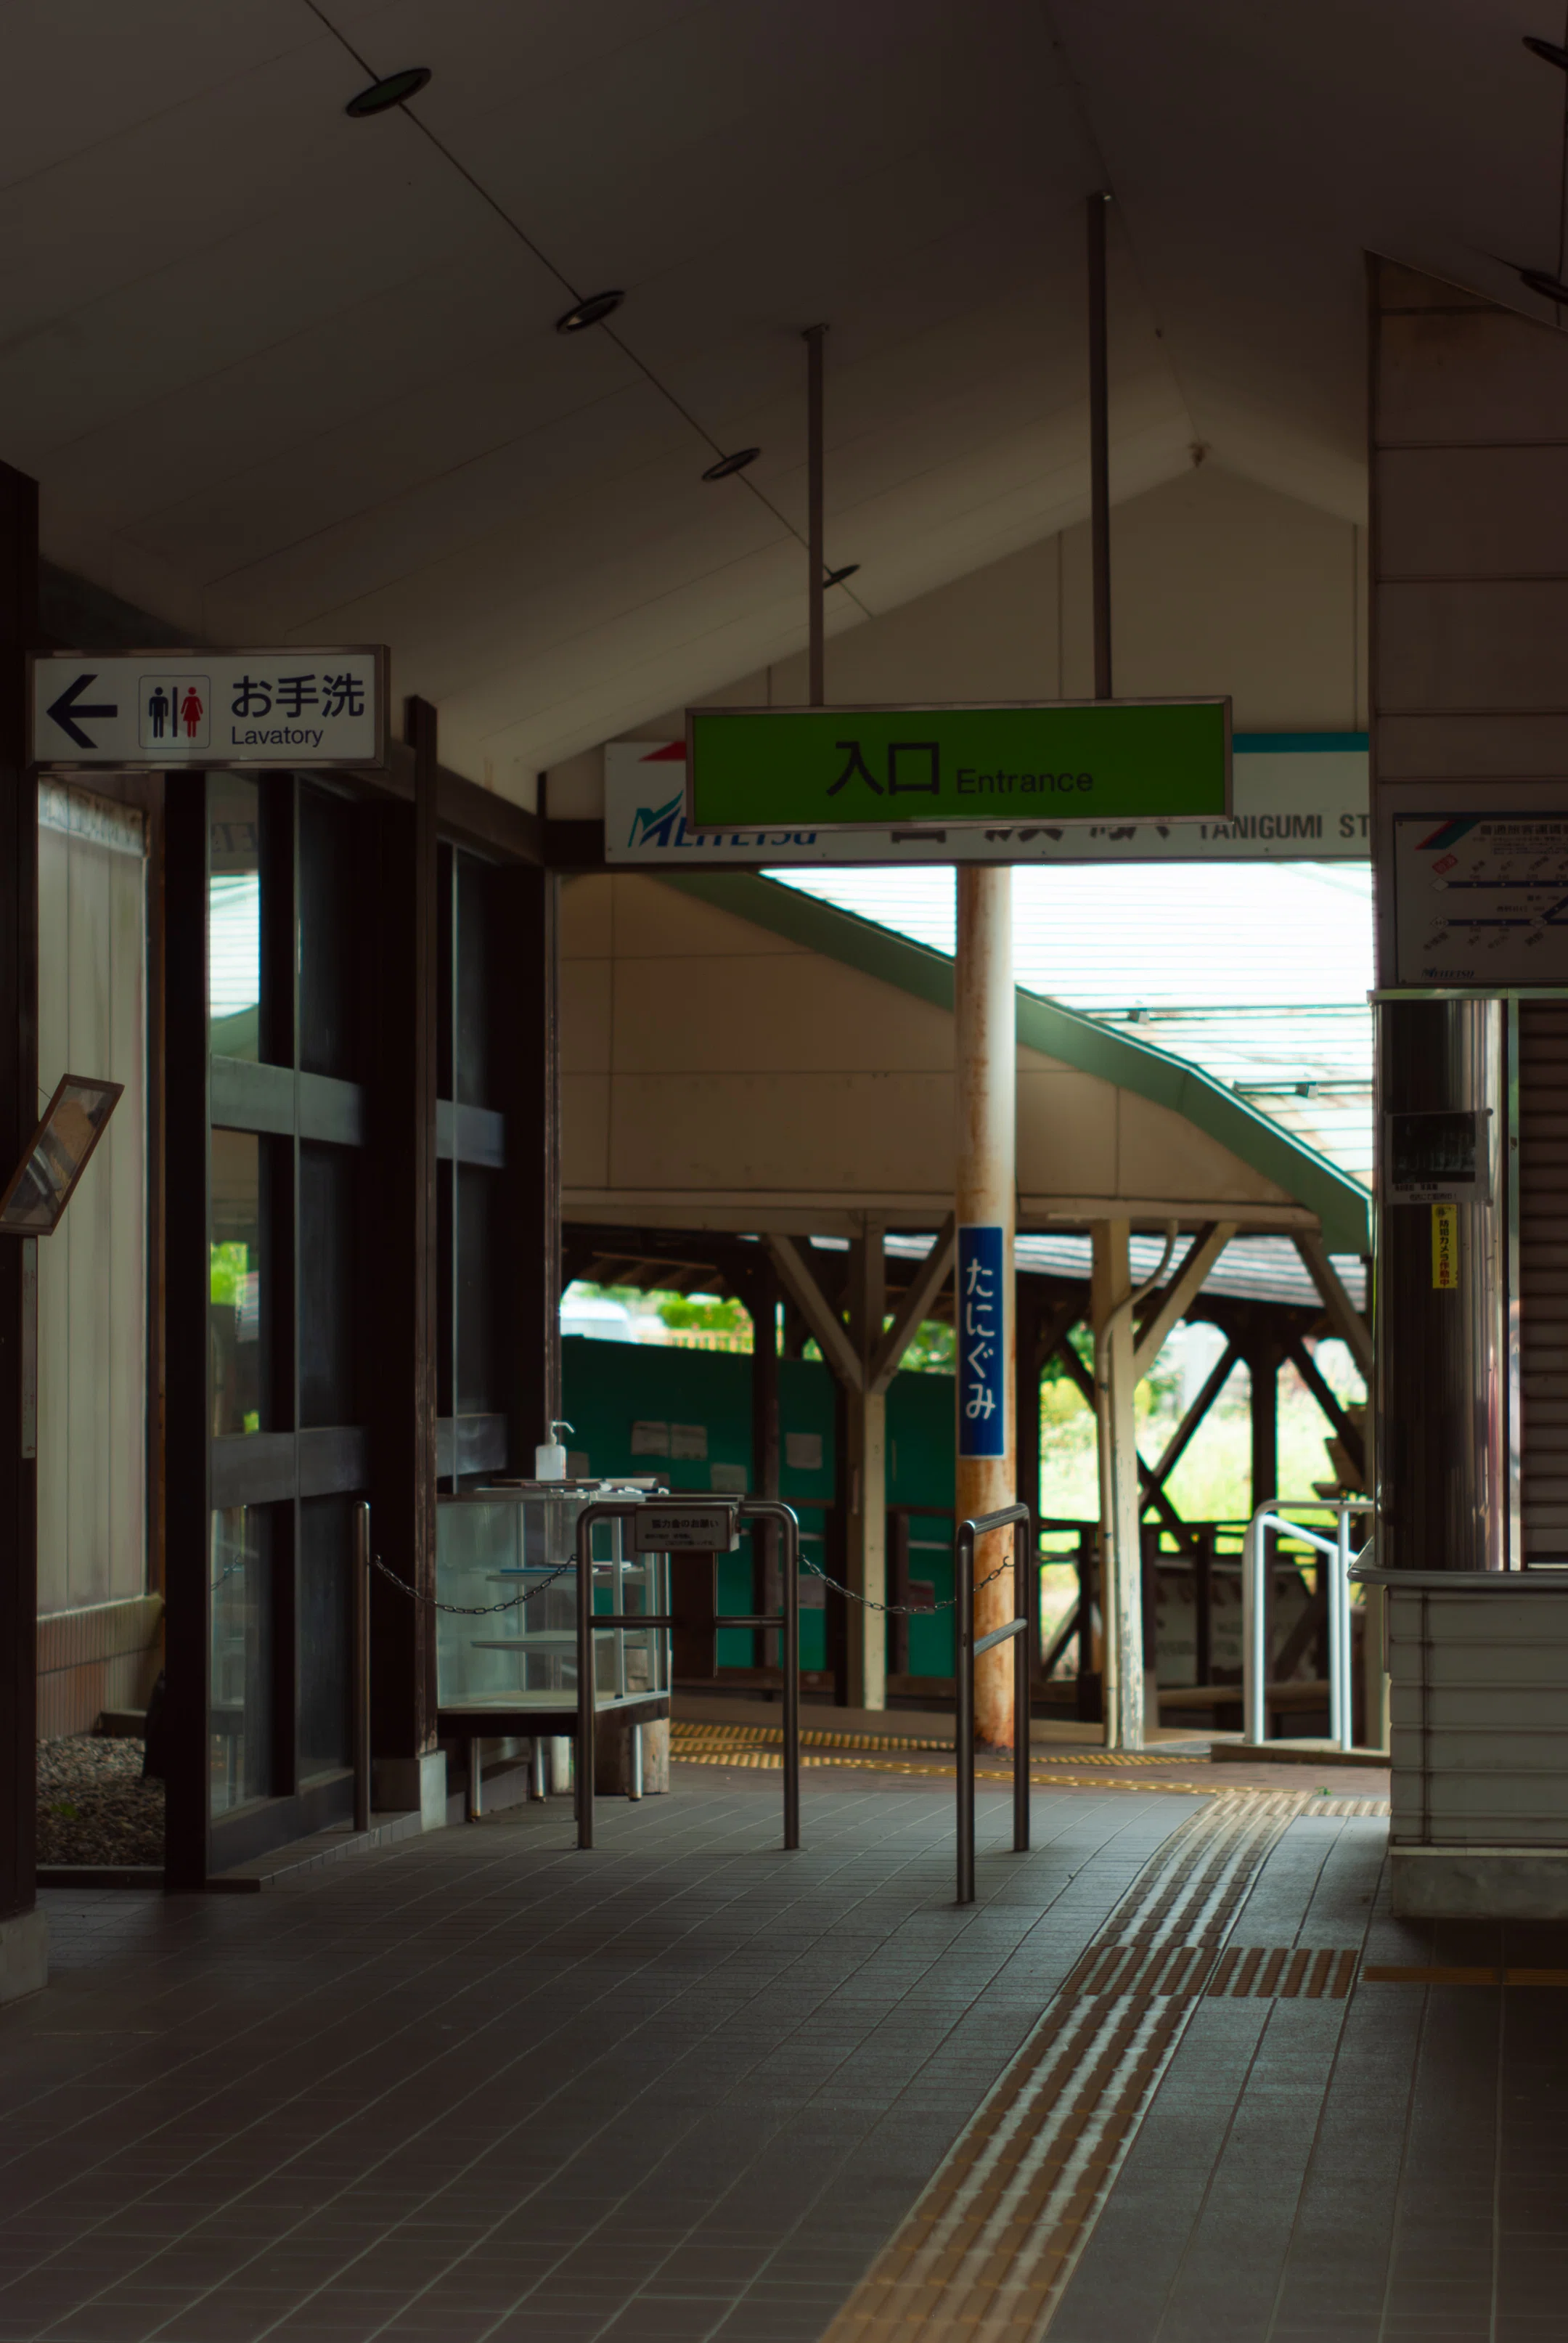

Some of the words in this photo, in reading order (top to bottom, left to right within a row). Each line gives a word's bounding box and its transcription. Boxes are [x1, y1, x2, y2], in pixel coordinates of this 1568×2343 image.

[231, 672, 364, 718] お手洗
[232, 726, 324, 748] Lavatory
[825, 741, 940, 797] 入口
[956, 768, 1094, 794] Entrance
[965, 1258, 996, 1420] たにぐみ
